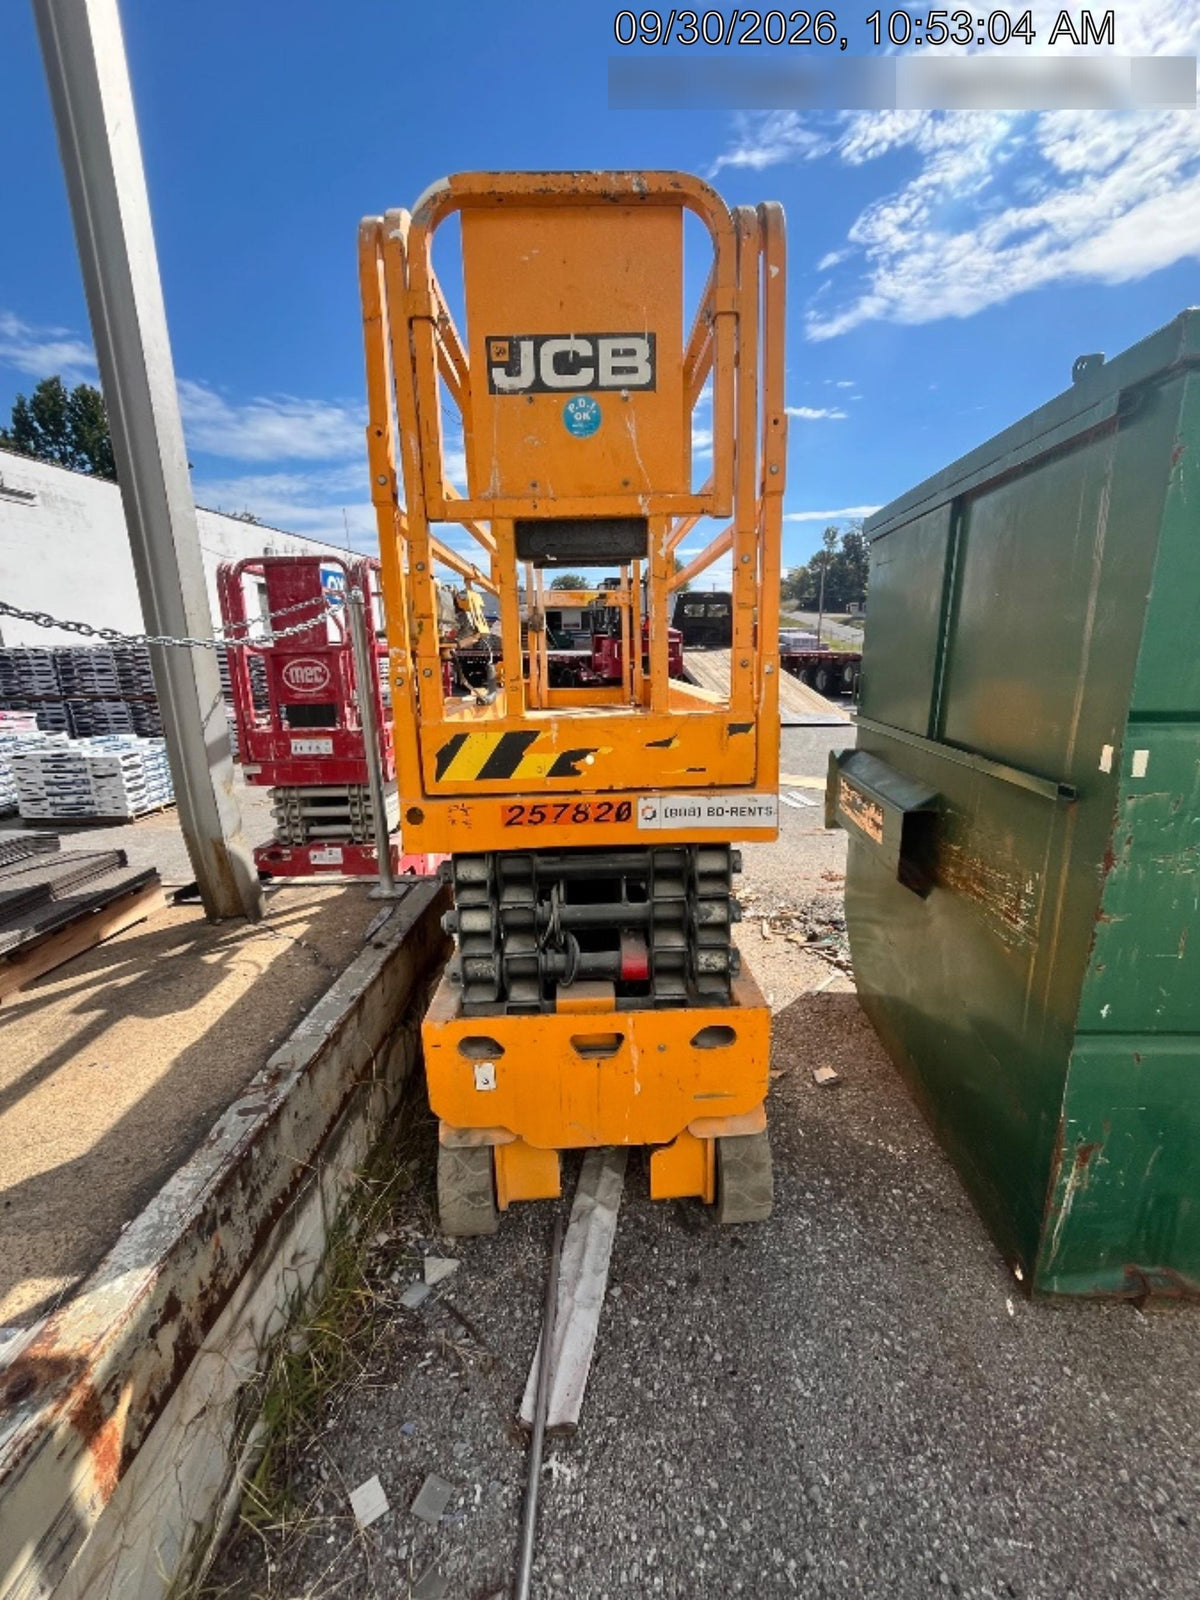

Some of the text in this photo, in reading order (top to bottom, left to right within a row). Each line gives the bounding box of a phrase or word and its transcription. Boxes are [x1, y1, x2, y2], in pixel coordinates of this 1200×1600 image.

[491, 336, 652, 390] JCB
[574, 411, 591, 421] OK
[504, 800, 632, 828] 257820
